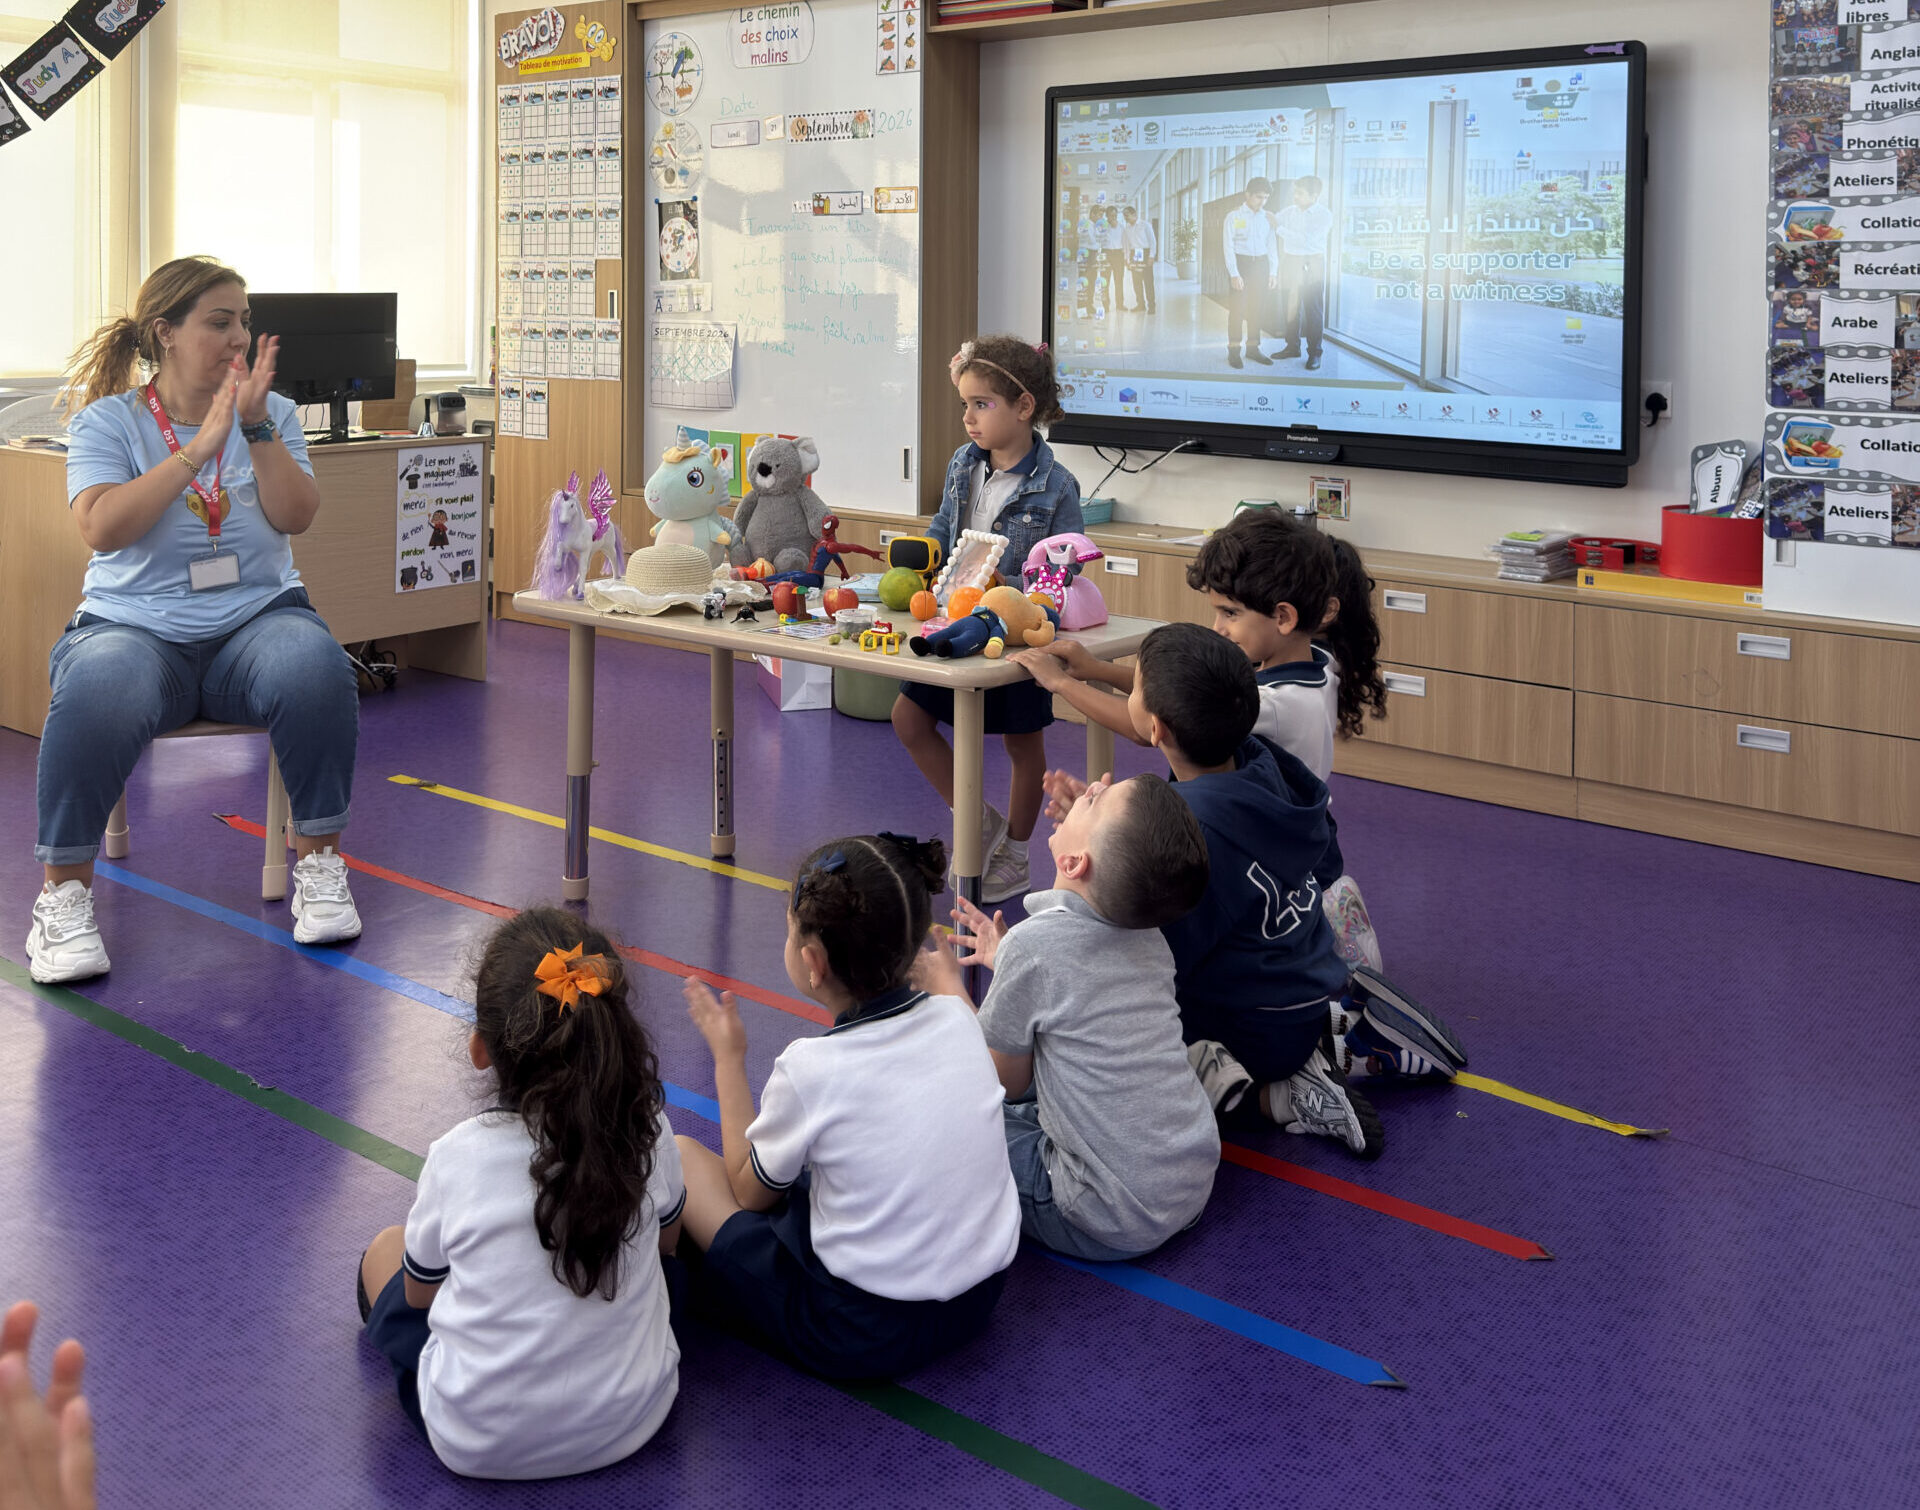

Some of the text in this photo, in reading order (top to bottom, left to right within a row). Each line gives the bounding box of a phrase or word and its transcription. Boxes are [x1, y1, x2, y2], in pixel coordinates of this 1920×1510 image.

[740, 5, 800, 23] Le chemin
[1846, 11, 1889, 23] libres
[500, 8, 555, 60] BRAVO!
[741, 26, 799, 45] des choix
[543, 60, 551, 68] de
[552, 56, 582, 66] motivation
[751, 48, 788, 65] malins
[22, 61, 61, 96] Judy
[795, 119, 850, 141] Septembre
[877, 108, 913, 133] 2026
[1833, 175, 1895, 187] Ateliers
[1440, 214, 1459, 233] لا
[1550, 211, 1594, 238] كن
[1369, 248, 1576, 275] Be a supporter
[1376, 280, 1565, 301] not a witness
[1831, 316, 1878, 329] Arabe
[654, 327, 729, 338] SEPTEMBRE 2026
[1828, 372, 1889, 385] Ateliers
[425, 456, 456, 467] Les mots
[424, 468, 456, 481] magiques
[1709, 464, 1722, 503] Album
[403, 498, 426, 511] merci
[451, 511, 477, 521] bonjour
[1828, 505, 1889, 520] Ateliers
[401, 524, 424, 541] de rien
[457, 530, 477, 541] revoir
[401, 546, 425, 560] pardon
[456, 547, 473, 558] merci
[1307, 1089, 1324, 1113] N
